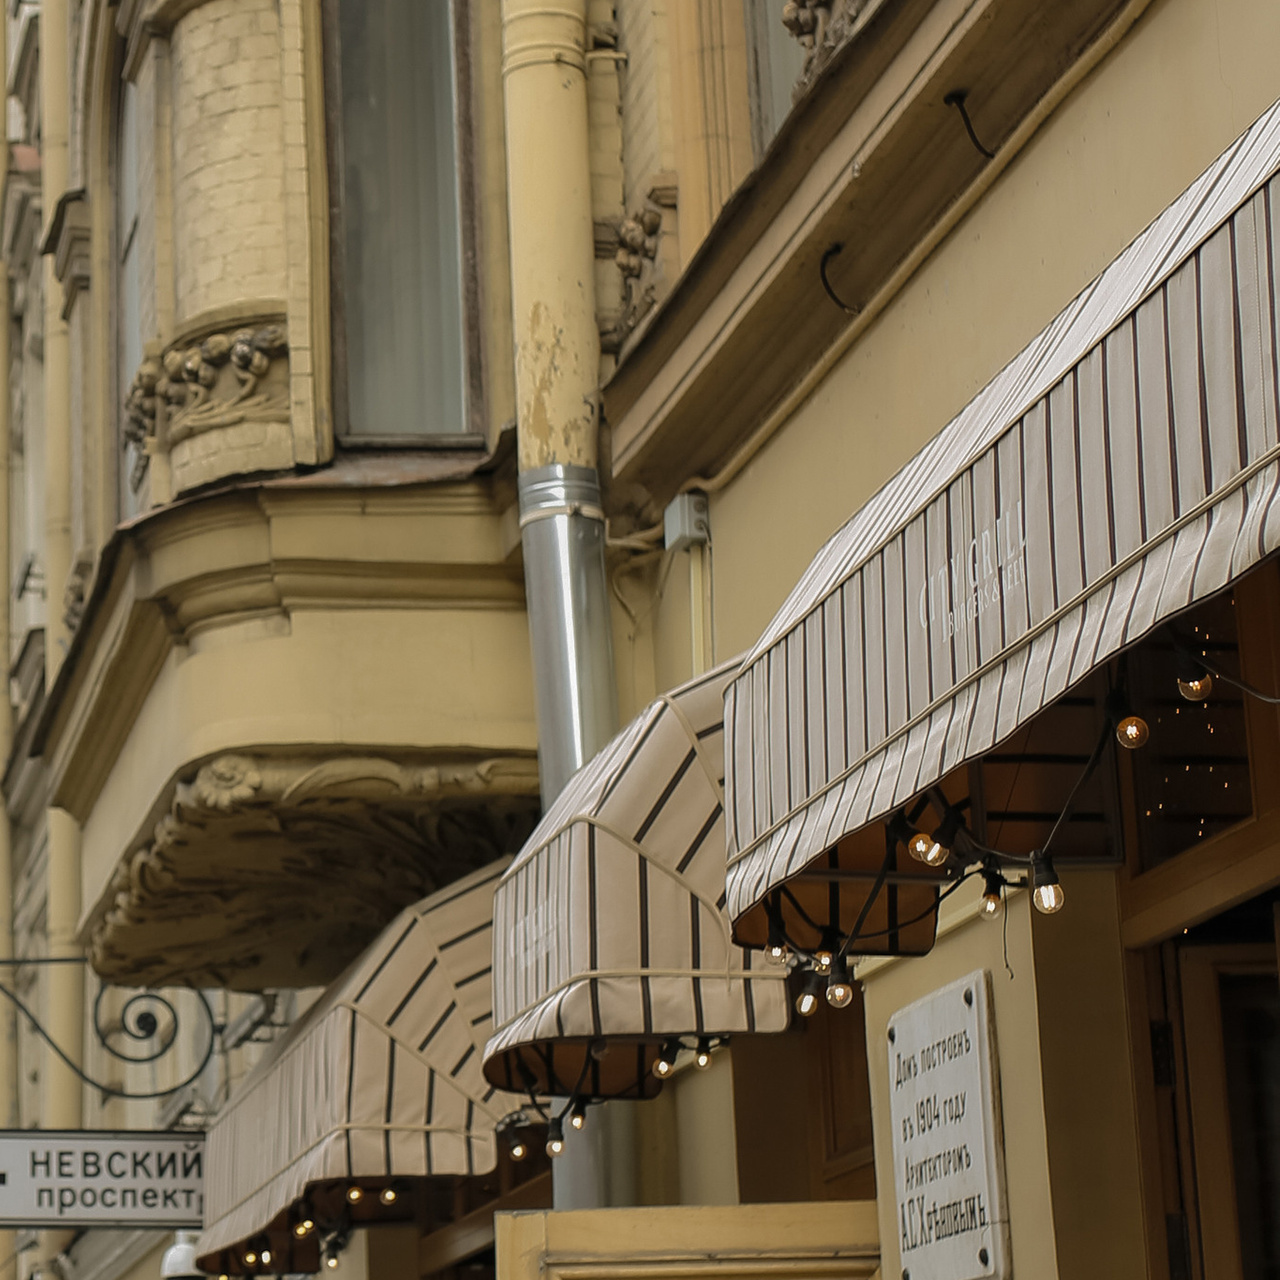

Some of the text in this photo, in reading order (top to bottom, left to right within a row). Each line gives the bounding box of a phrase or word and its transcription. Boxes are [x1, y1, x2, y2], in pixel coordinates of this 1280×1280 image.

[920, 500, 1026, 643] CITY GRILL
[916, 1094, 940, 1136] 1904
[30, 1143, 203, 1179] НЕВСКИЙ
[37, 1186, 196, 1216] проспект
